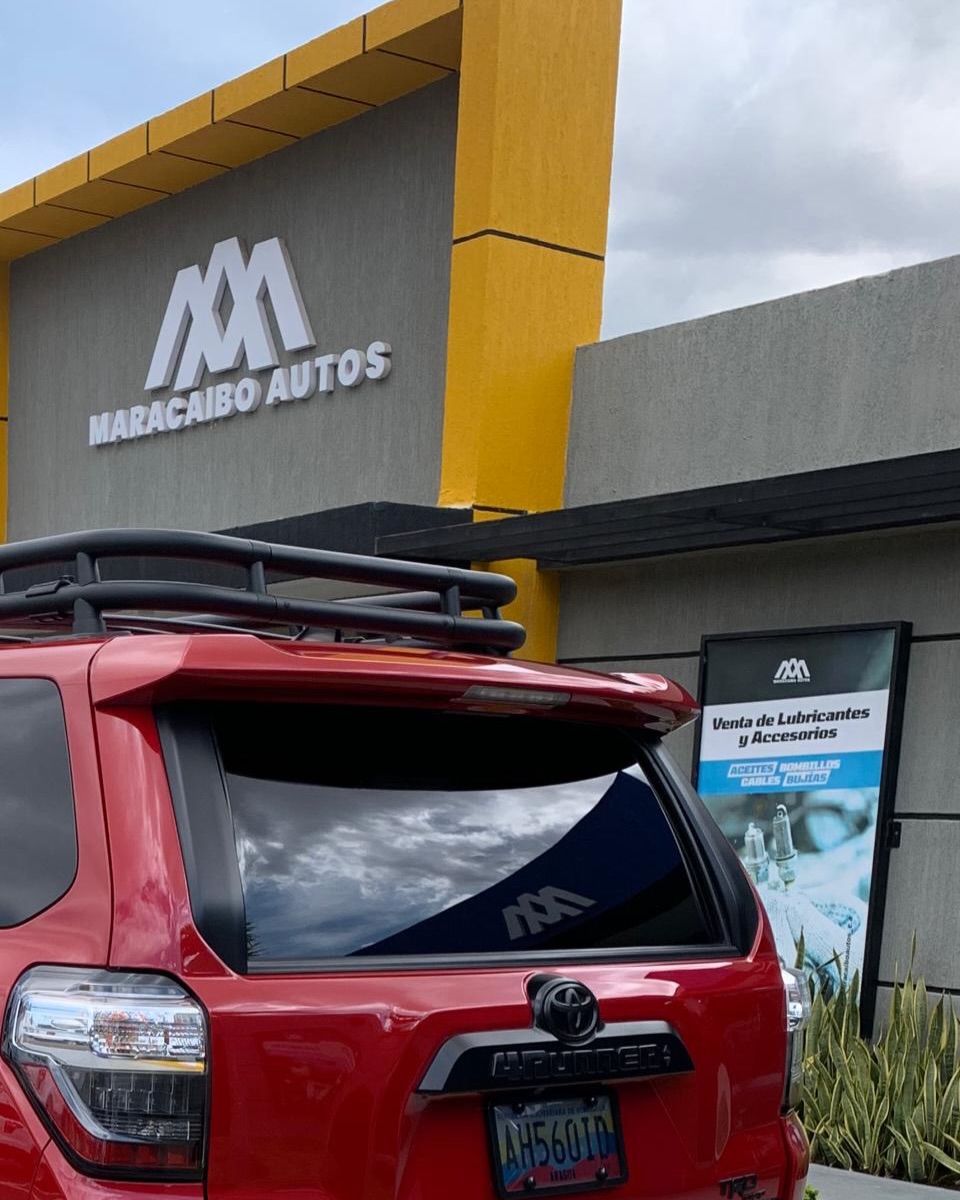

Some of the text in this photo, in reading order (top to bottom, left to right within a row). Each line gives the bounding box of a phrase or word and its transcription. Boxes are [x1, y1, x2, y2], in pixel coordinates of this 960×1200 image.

[89, 341, 392, 446] MARACAIBO AUTOS
[712, 707, 870, 730] Venta de Lubricantes
[738, 726, 838, 748] y Accesorios
[730, 759, 840, 776] ACEITES BOMBILLOS
[741, 776, 781, 787] CABLES
[505, 1114, 610, 1171] AH560ID
